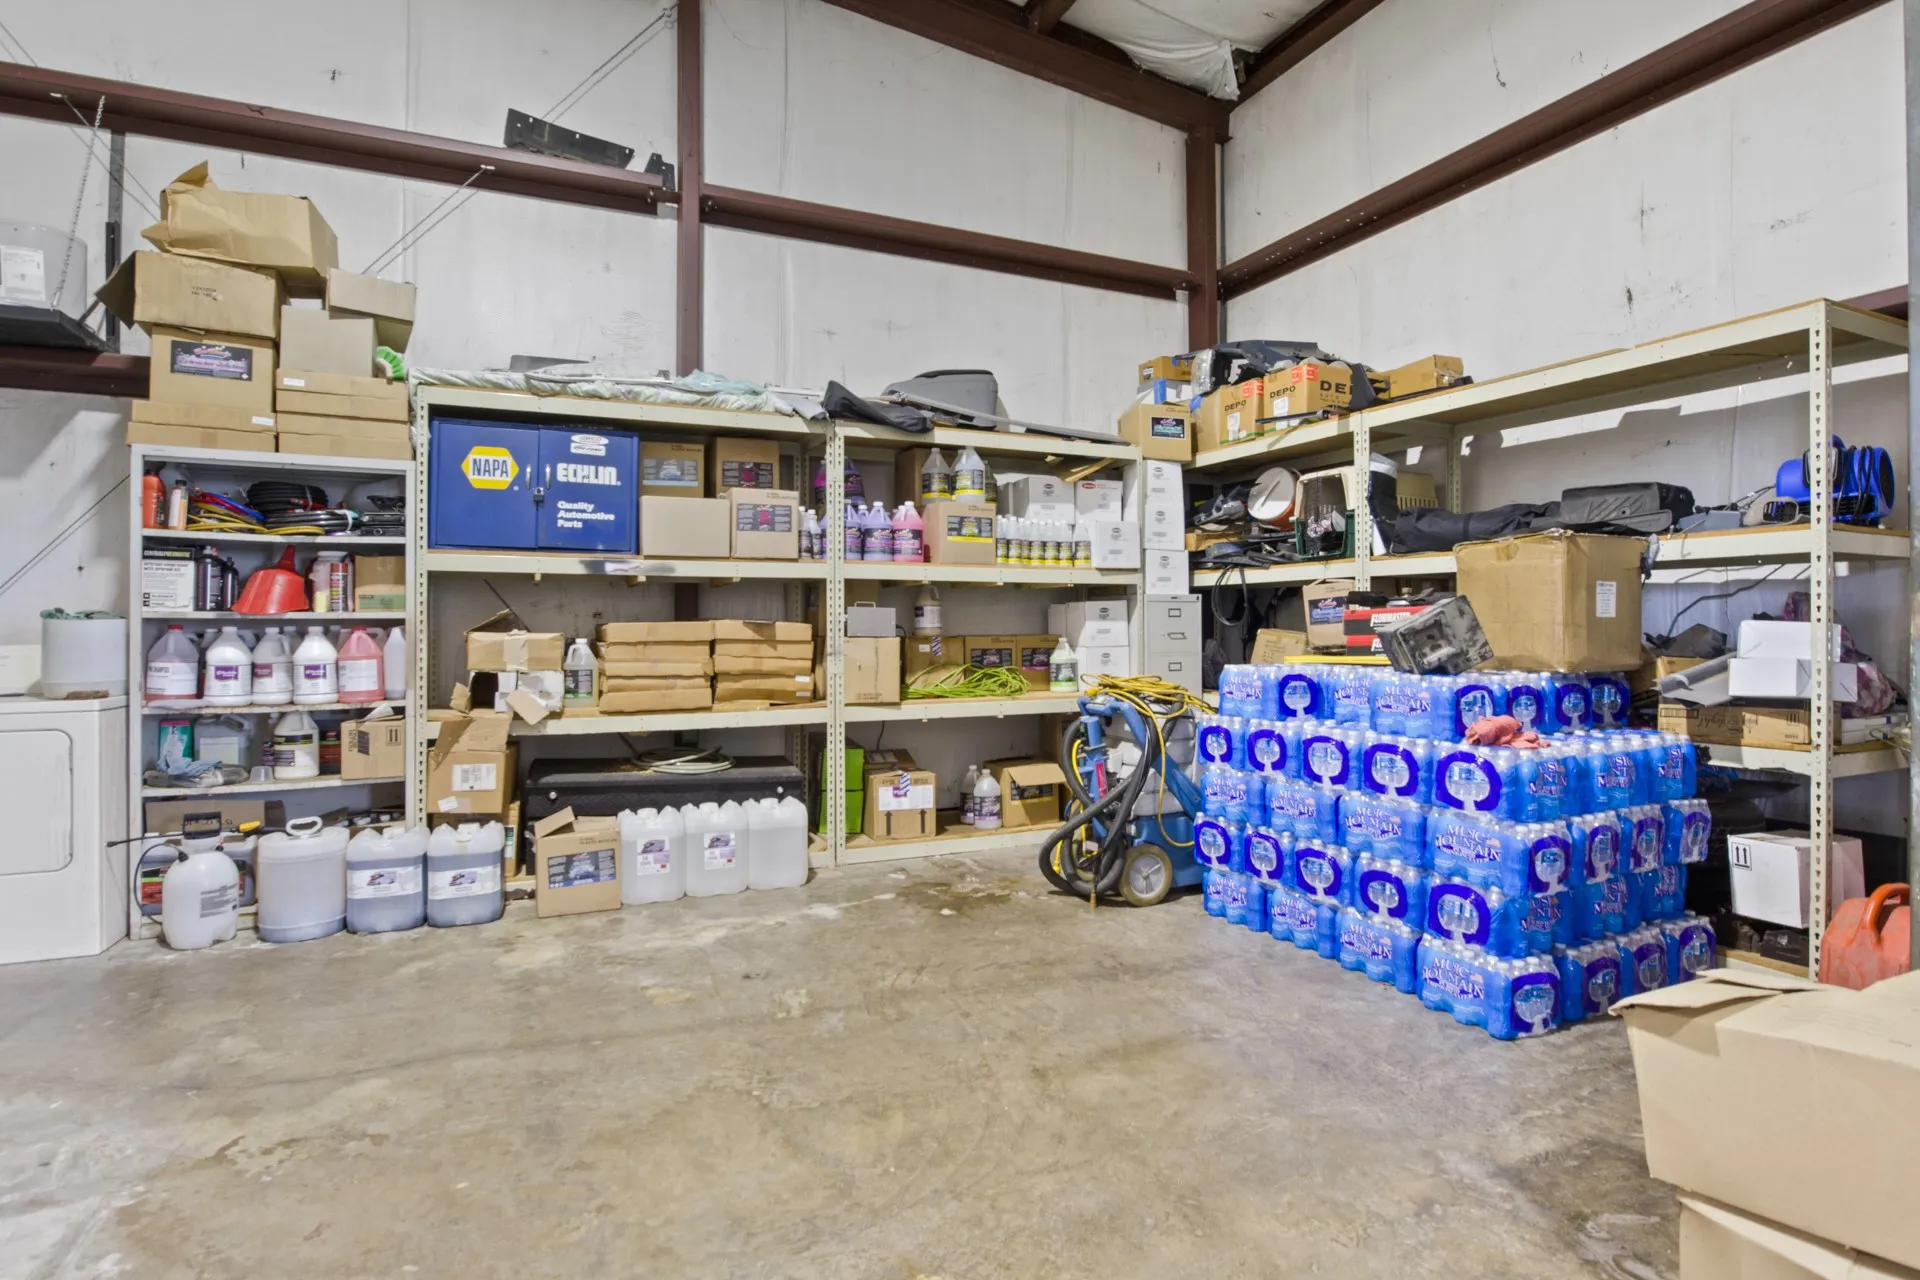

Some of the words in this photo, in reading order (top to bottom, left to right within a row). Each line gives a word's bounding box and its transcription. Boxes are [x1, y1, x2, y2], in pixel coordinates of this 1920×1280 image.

[1269, 385, 1296, 399] DEPO
[1224, 400, 1247, 411] DEPO
[472, 458, 509, 478] NAPA
[557, 463, 617, 485] ECHLIN
[557, 501, 595, 512] Quality
[557, 510, 615, 520] Automotive
[557, 519, 583, 528] Parts
[1447, 825, 1486, 842] MUSIC
[1435, 834, 1500, 862] MOUNTAIN
[1433, 957, 1470, 978] MUSIC
